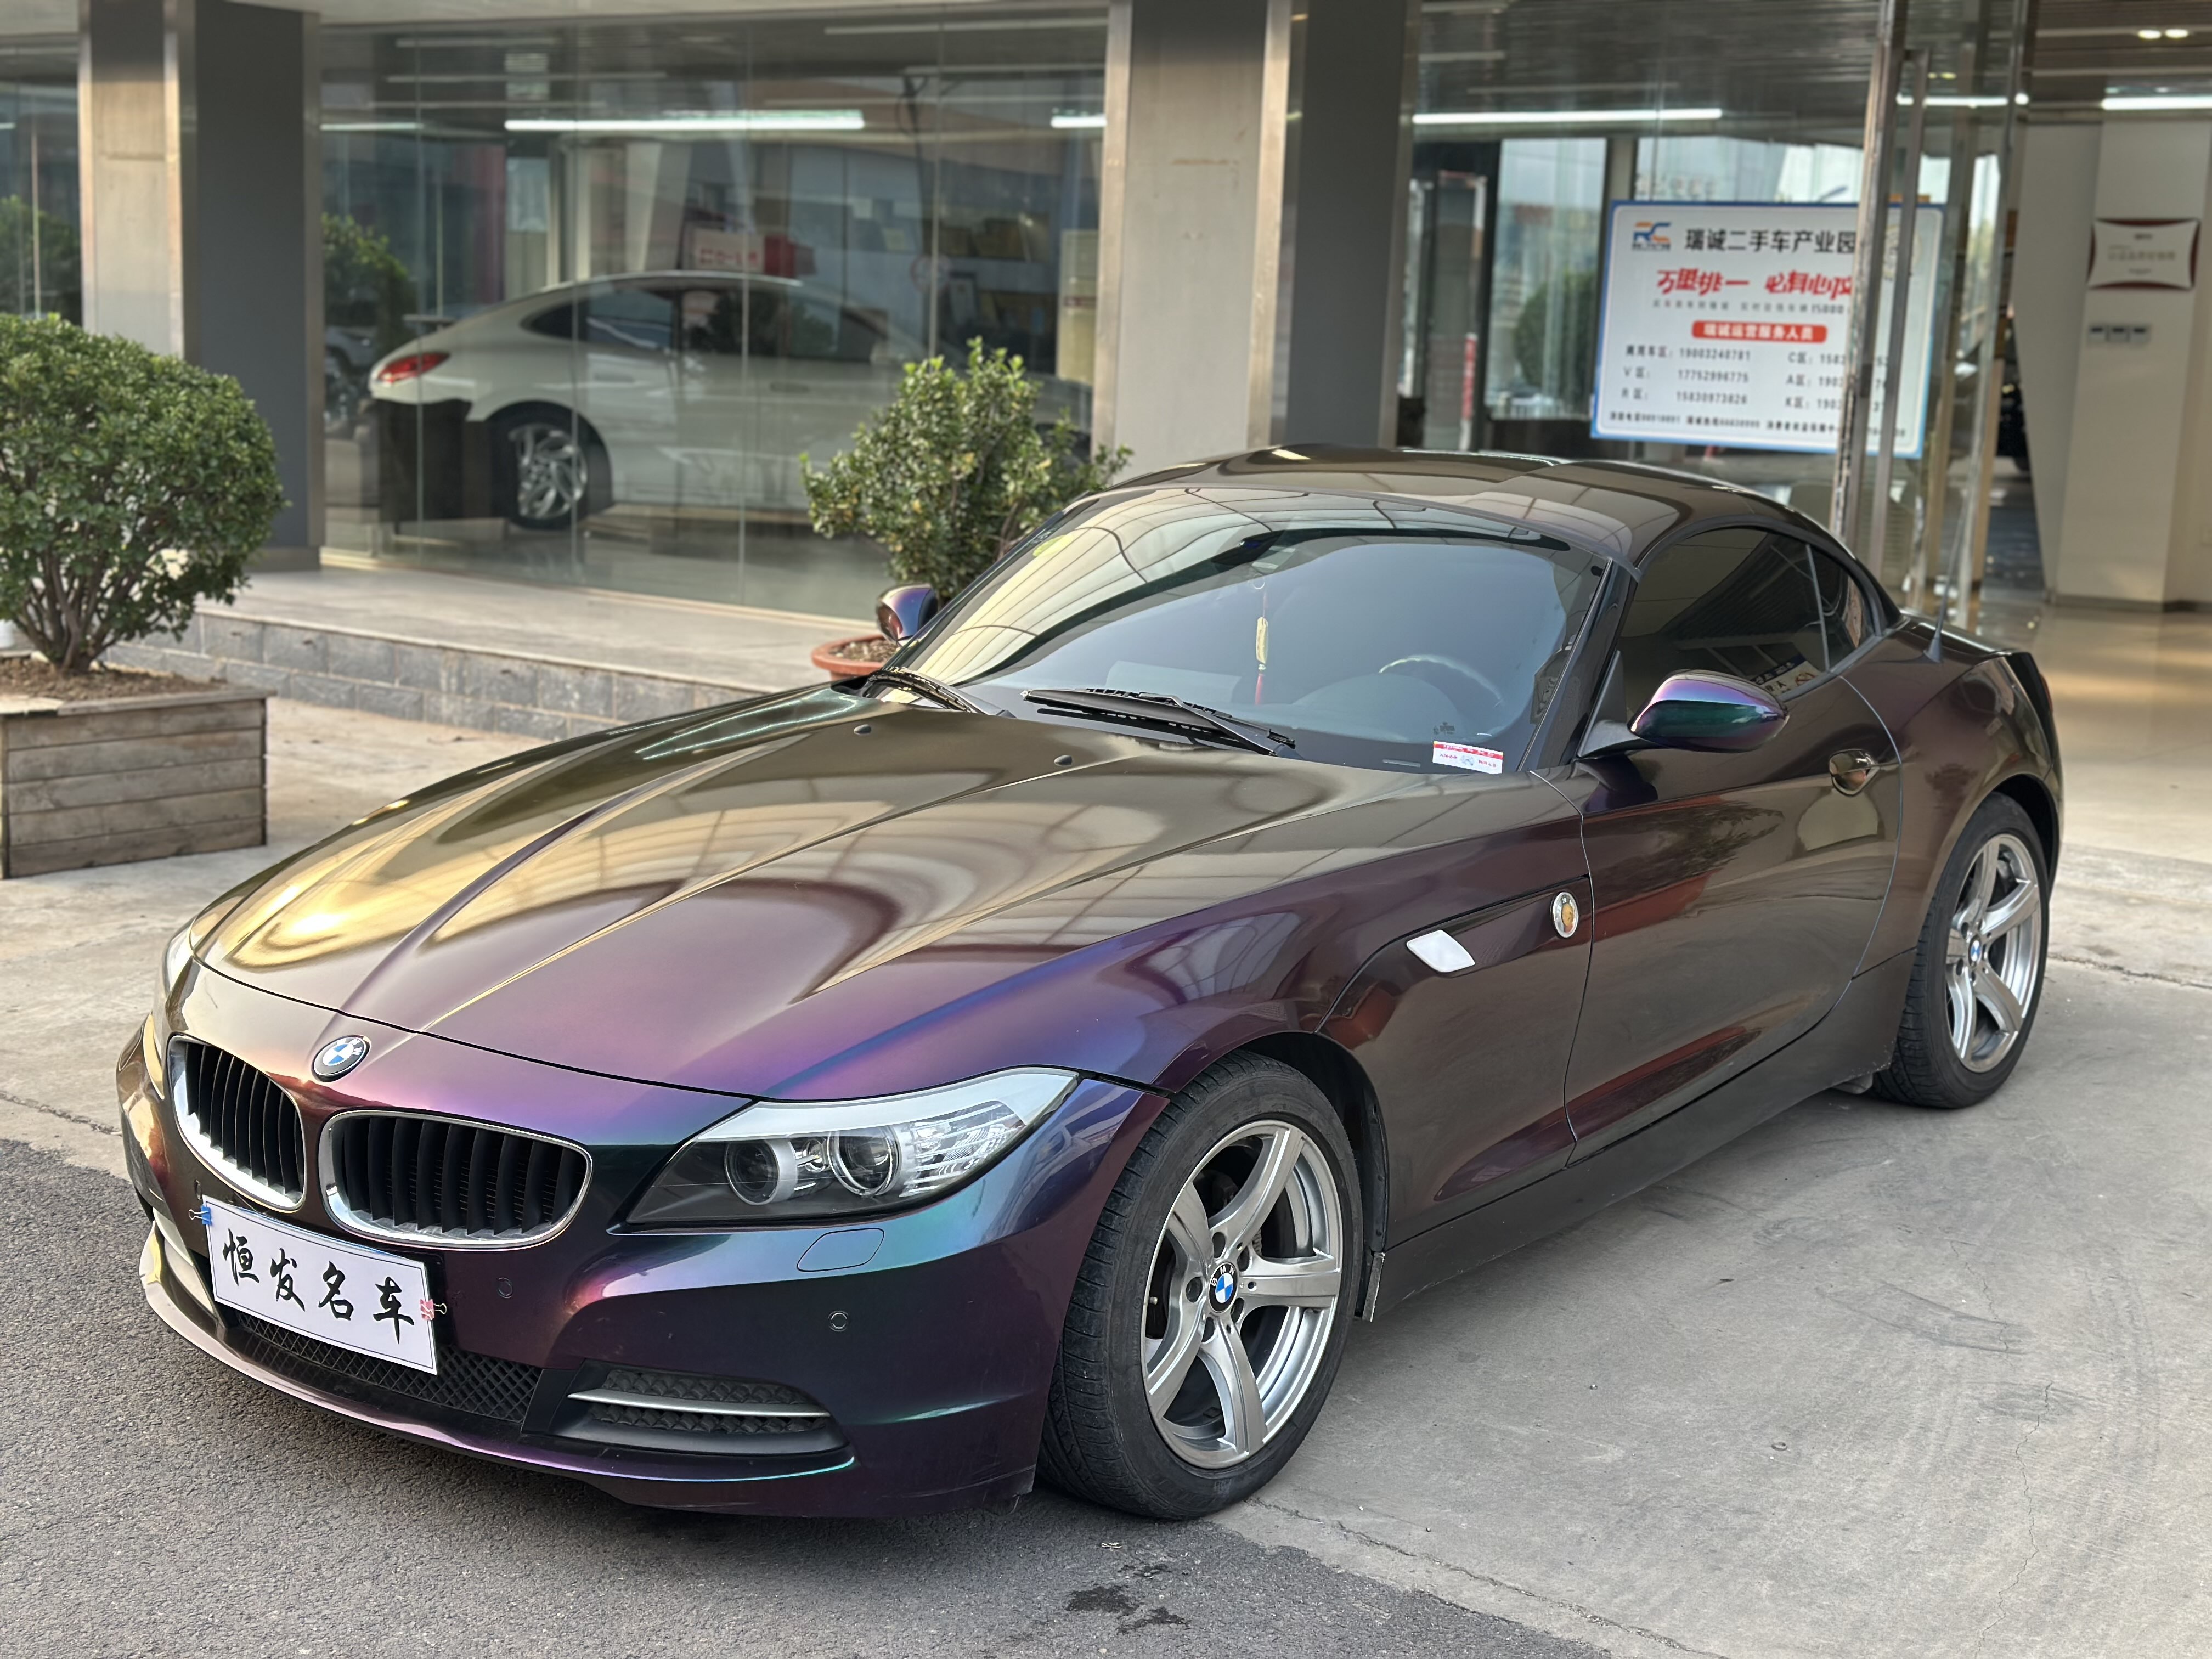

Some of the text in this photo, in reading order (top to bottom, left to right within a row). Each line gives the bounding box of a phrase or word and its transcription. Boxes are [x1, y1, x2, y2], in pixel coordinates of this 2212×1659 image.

[1685, 229, 1857, 254] 瑞诚二手车产业园
[222, 1228, 415, 1345] 恒发名车
[1211, 1265, 1235, 1287] BMW
